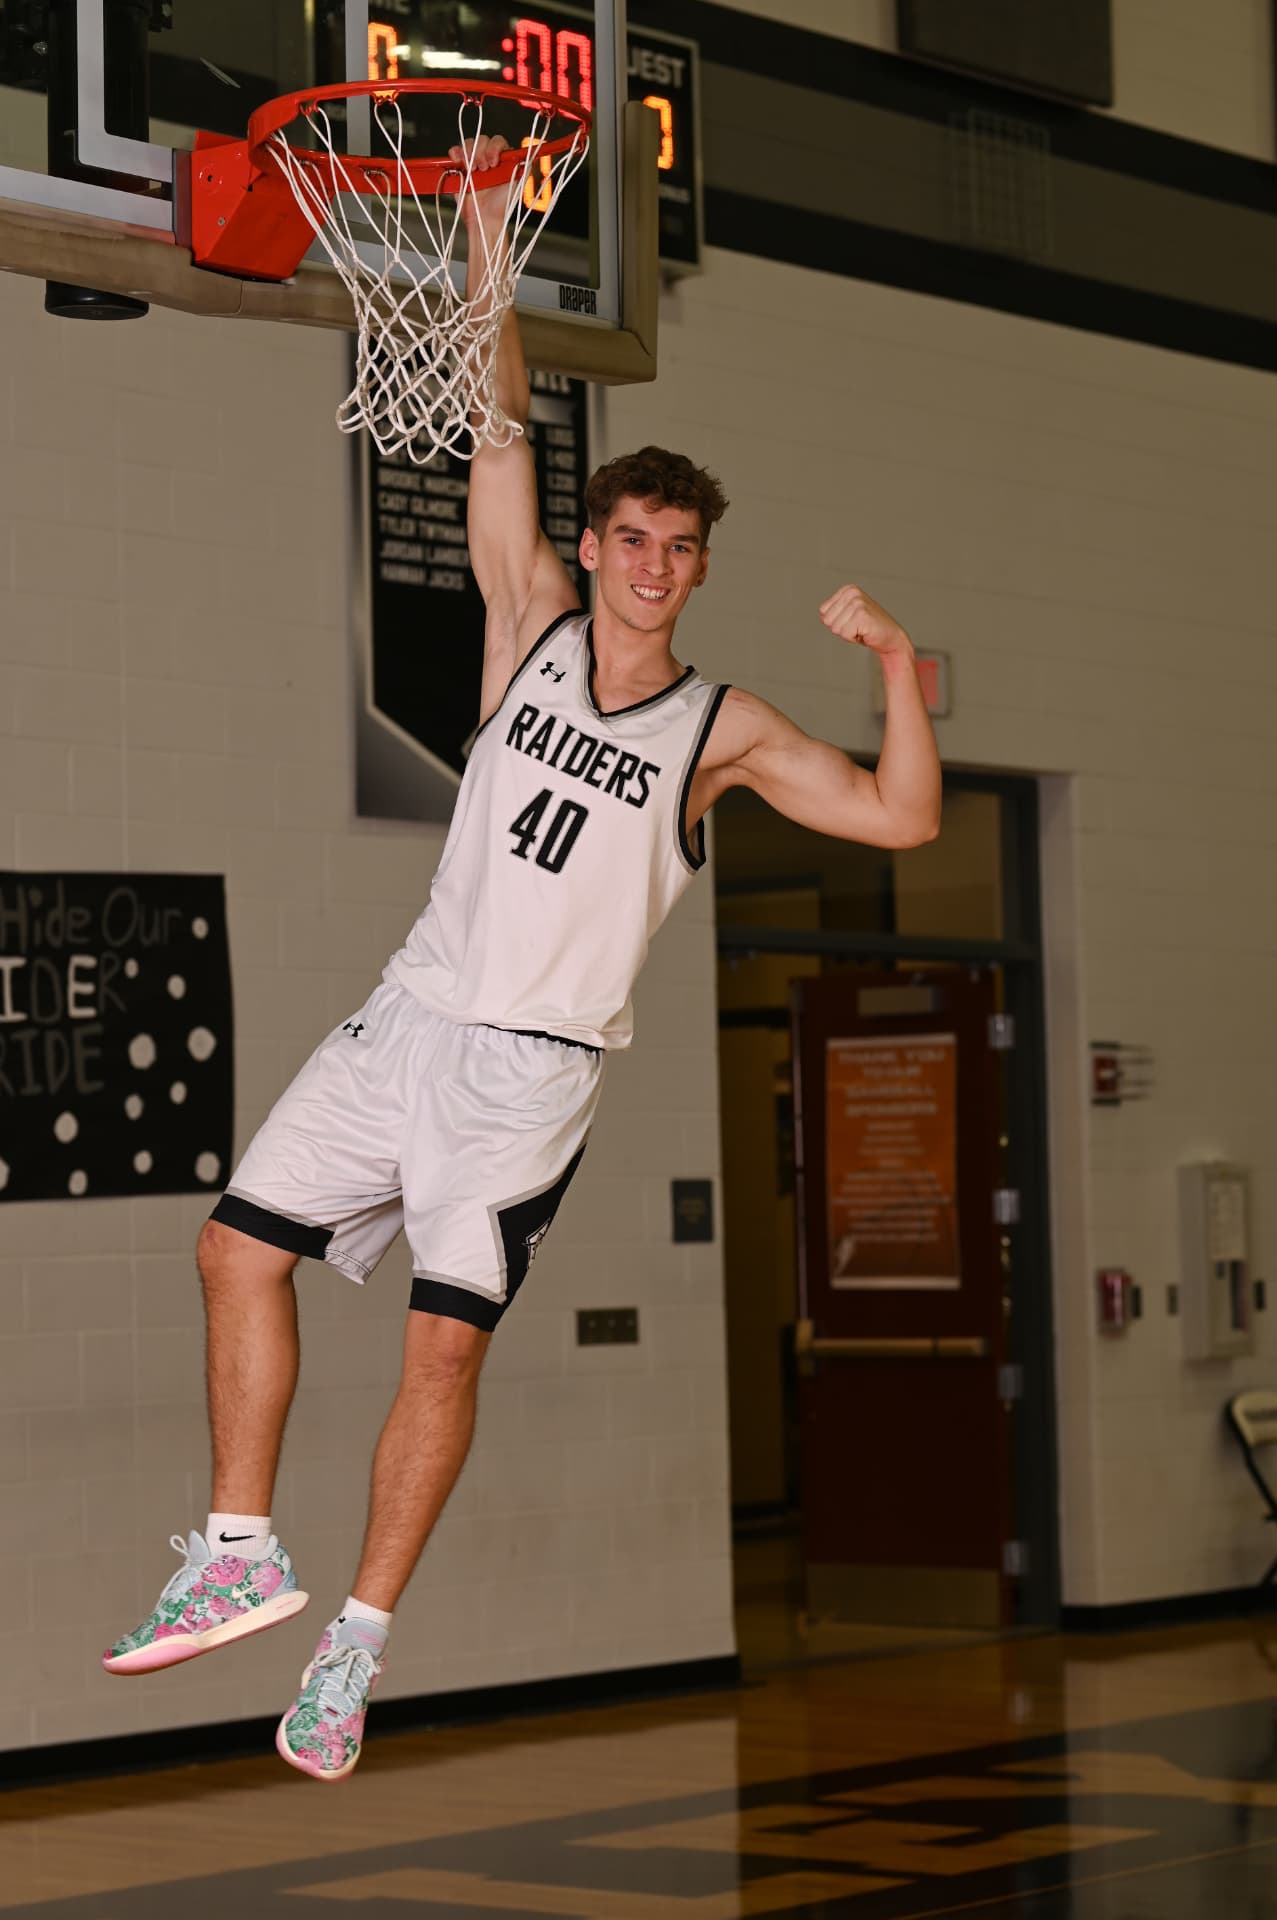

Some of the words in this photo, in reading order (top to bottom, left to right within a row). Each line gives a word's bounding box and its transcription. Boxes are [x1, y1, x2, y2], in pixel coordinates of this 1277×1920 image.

[559, 284, 597, 315] DRAPER
[505, 702, 662, 809] RAIDERS
[508, 786, 590, 875] 40
[0, 879, 91, 952] Hide
[101, 886, 183, 947] Our
